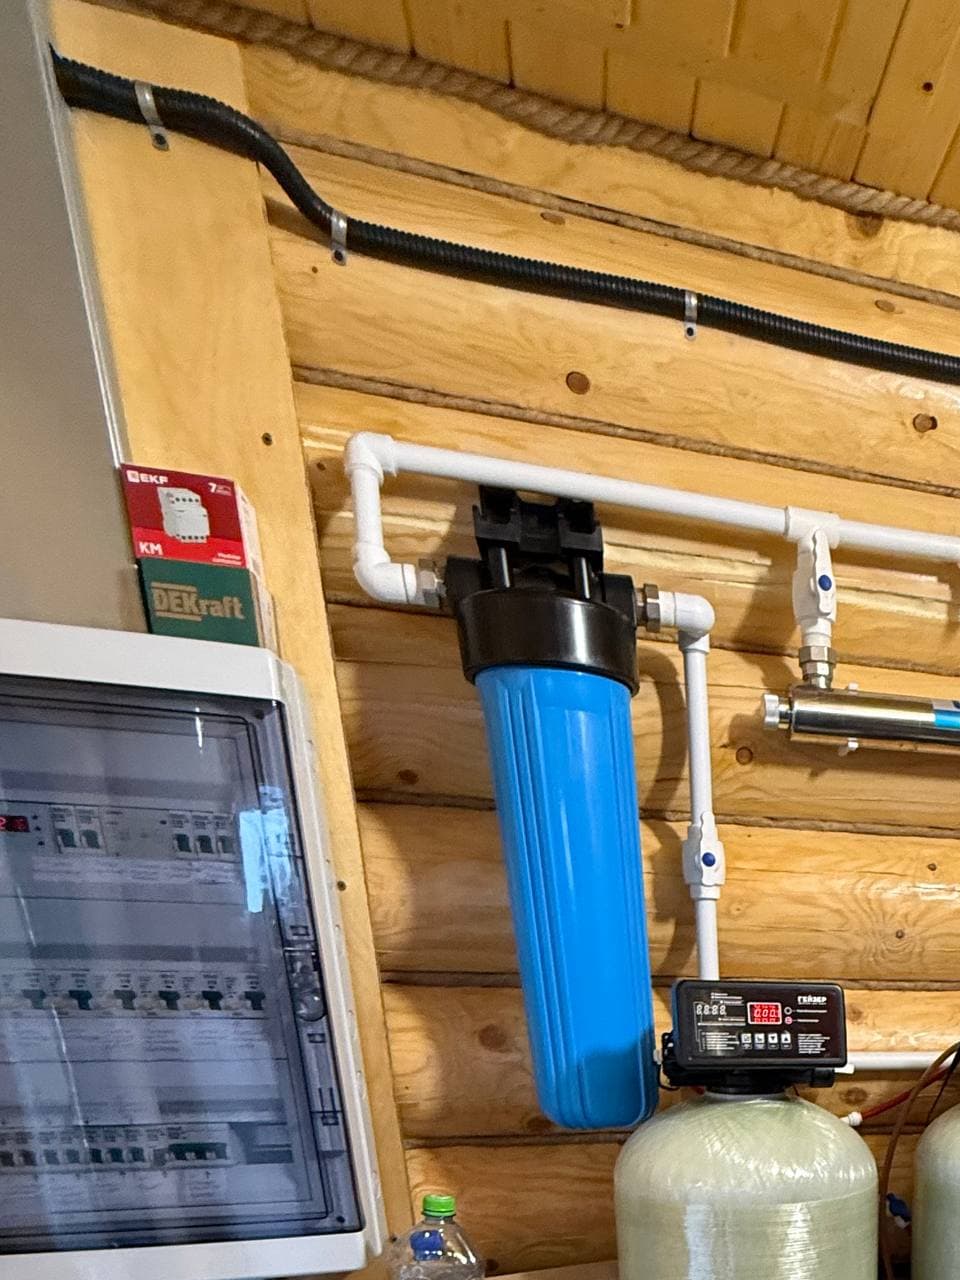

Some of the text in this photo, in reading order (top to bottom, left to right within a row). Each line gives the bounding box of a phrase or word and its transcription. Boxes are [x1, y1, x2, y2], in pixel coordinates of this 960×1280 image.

[139, 474, 168, 484] EKF
[138, 542, 163, 555] KM
[152, 586, 245, 620] DEKraft
